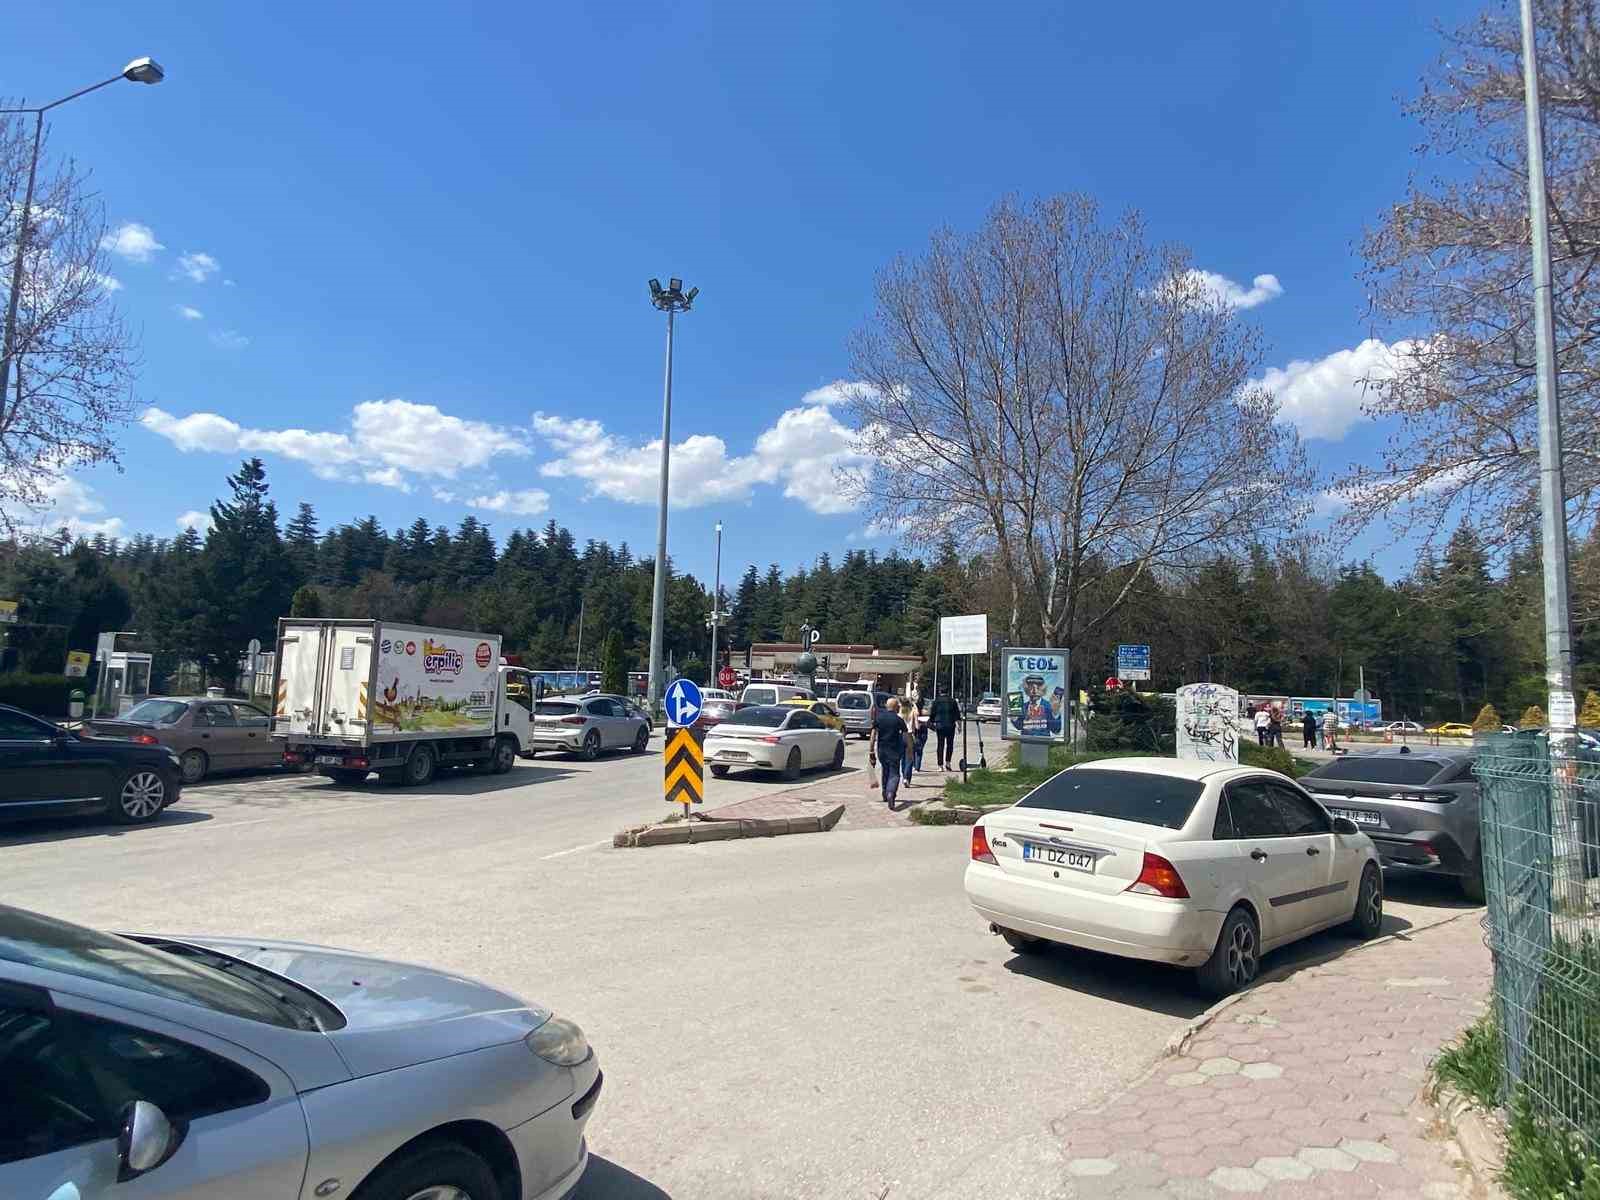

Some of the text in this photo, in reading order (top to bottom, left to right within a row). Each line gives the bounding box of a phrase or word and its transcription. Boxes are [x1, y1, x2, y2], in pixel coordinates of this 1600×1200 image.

[1014, 656, 1058, 671] TEOL
[1032, 846, 1092, 868] 11 DZ 047
